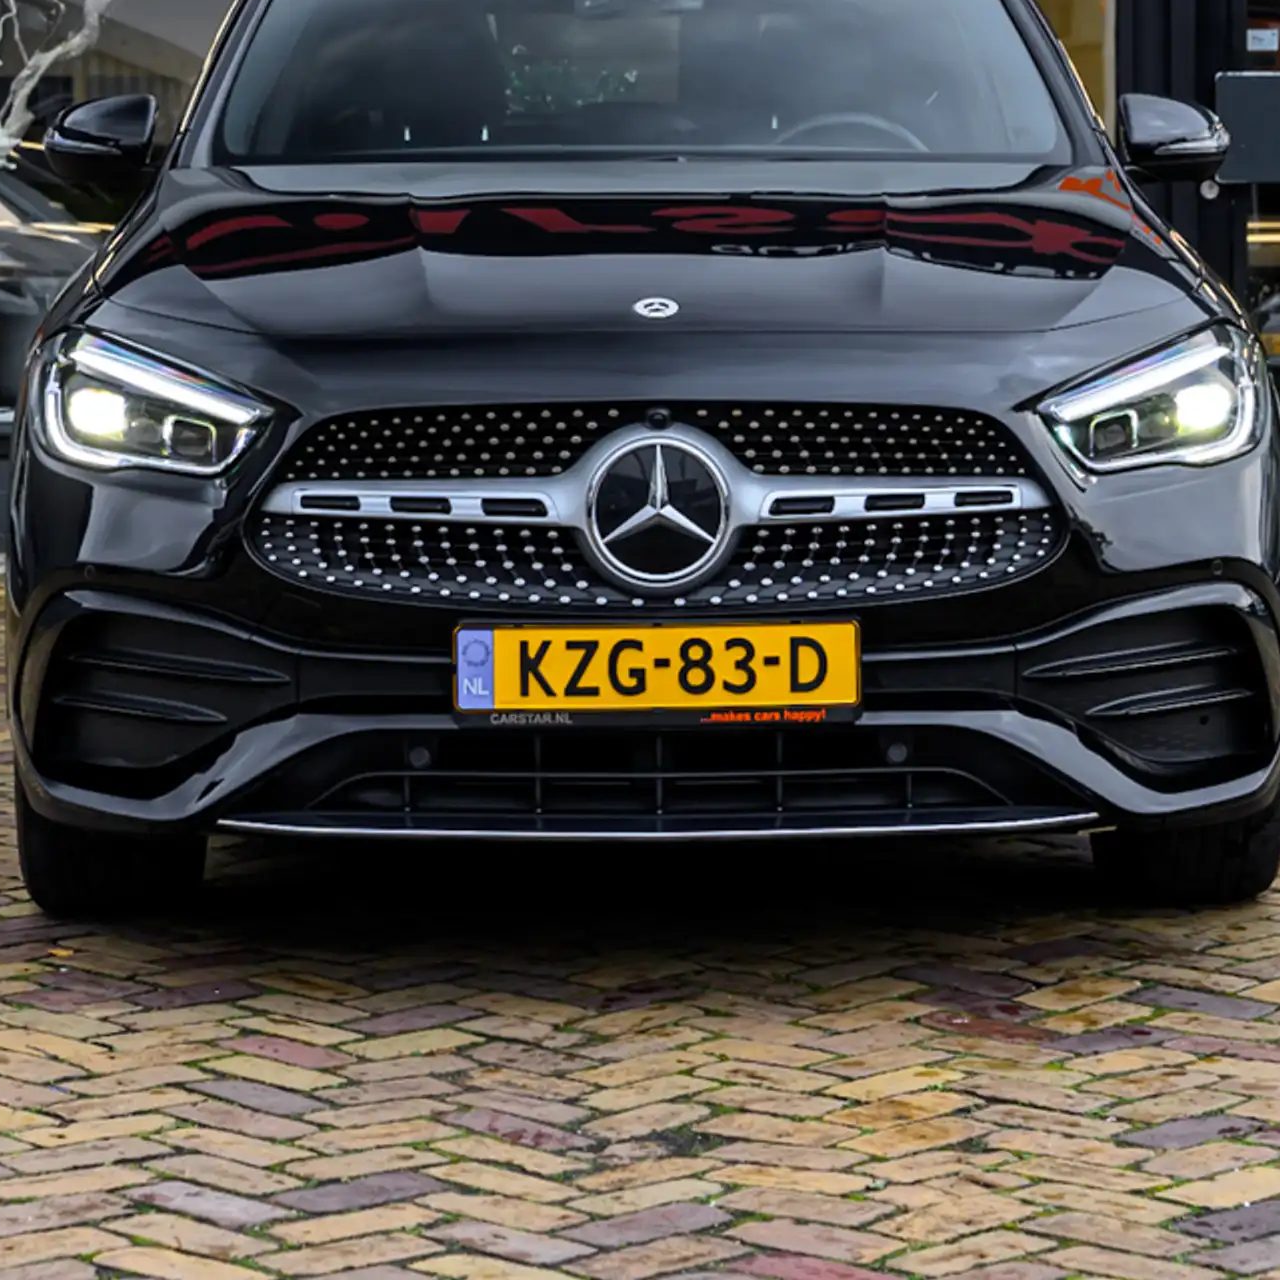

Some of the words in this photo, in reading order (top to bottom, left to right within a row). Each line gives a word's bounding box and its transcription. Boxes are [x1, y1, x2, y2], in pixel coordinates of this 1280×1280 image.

[519, 636, 828, 697] KZG-83-D
[463, 677, 490, 696] NL
[490, 711, 573, 725] CARSTAR.NL
[754, 711, 781, 722] cars
[784, 707, 827, 723] happy!
